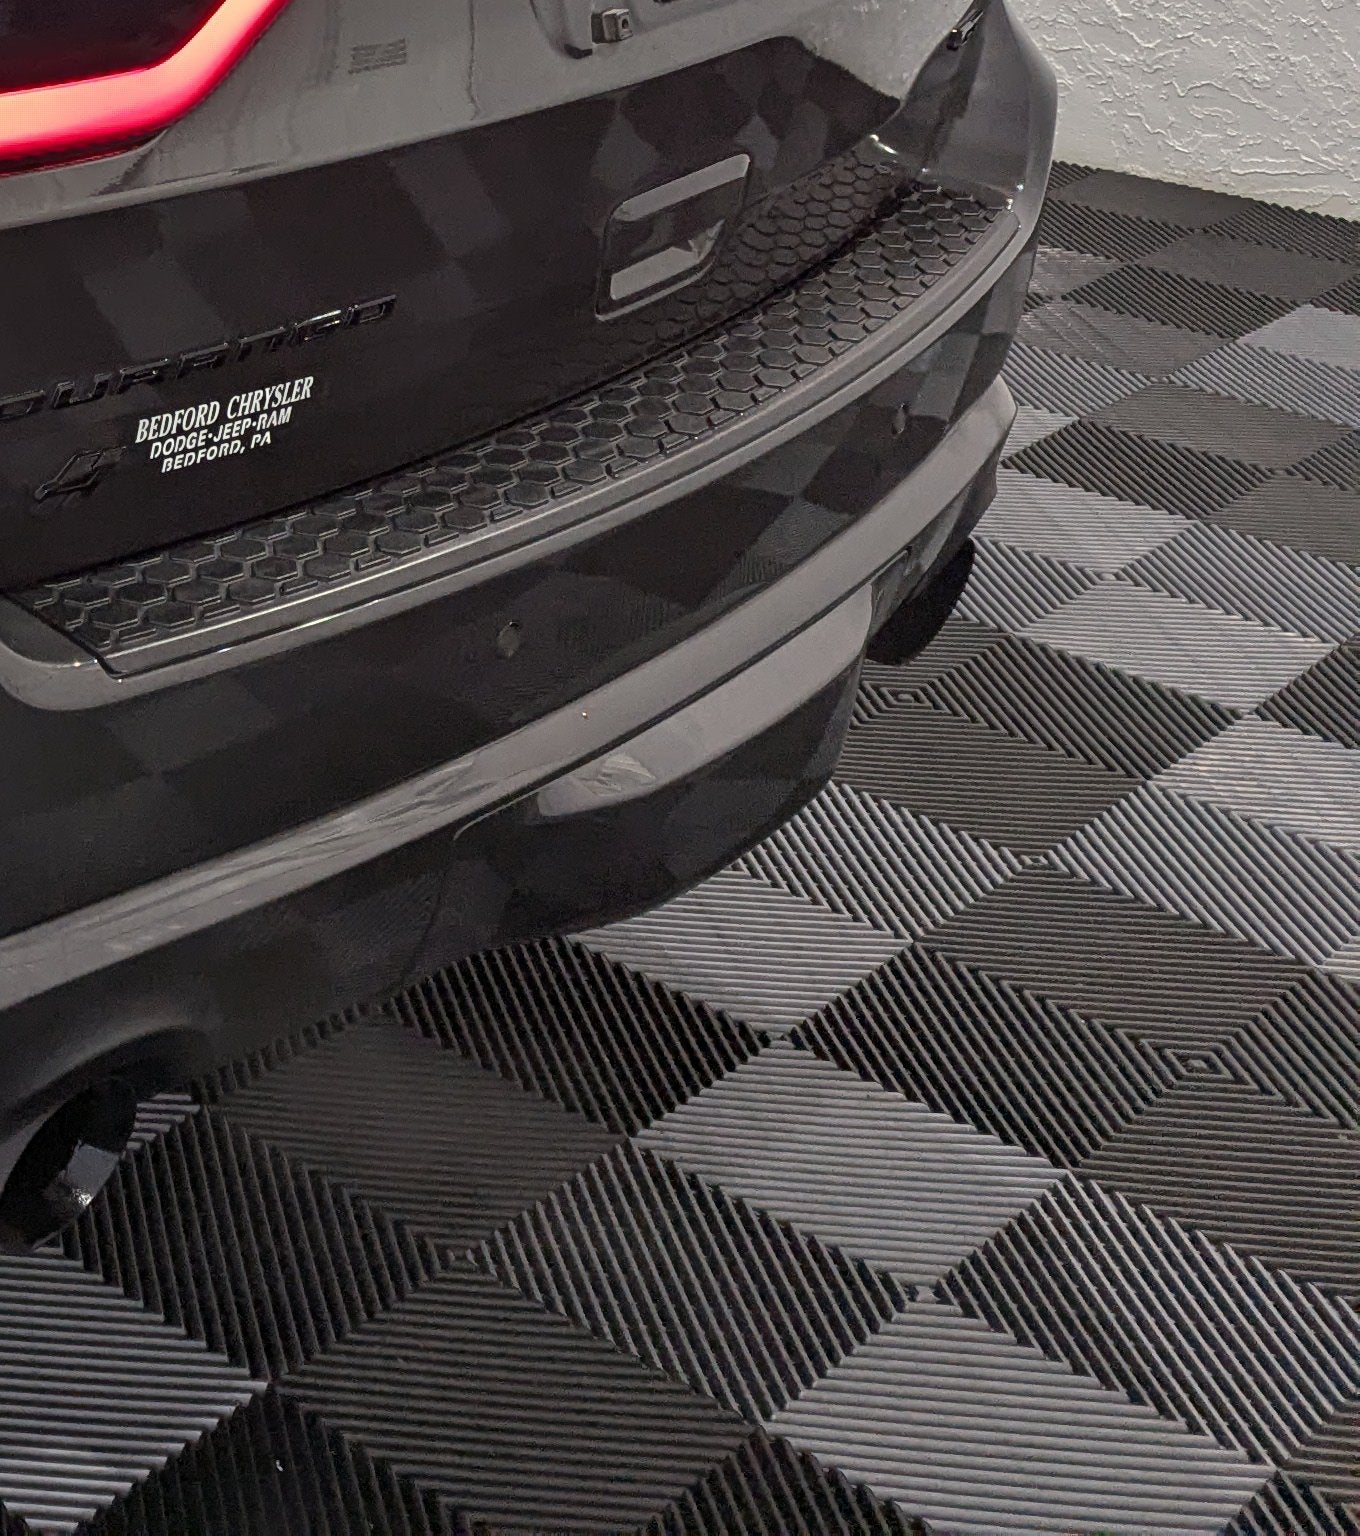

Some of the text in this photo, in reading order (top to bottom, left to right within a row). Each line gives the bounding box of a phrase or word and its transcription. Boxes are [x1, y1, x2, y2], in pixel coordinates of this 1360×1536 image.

[135, 376, 314, 444] BEDFORD CHRYSLER
[161, 431, 272, 473] BEDFORD, PA
